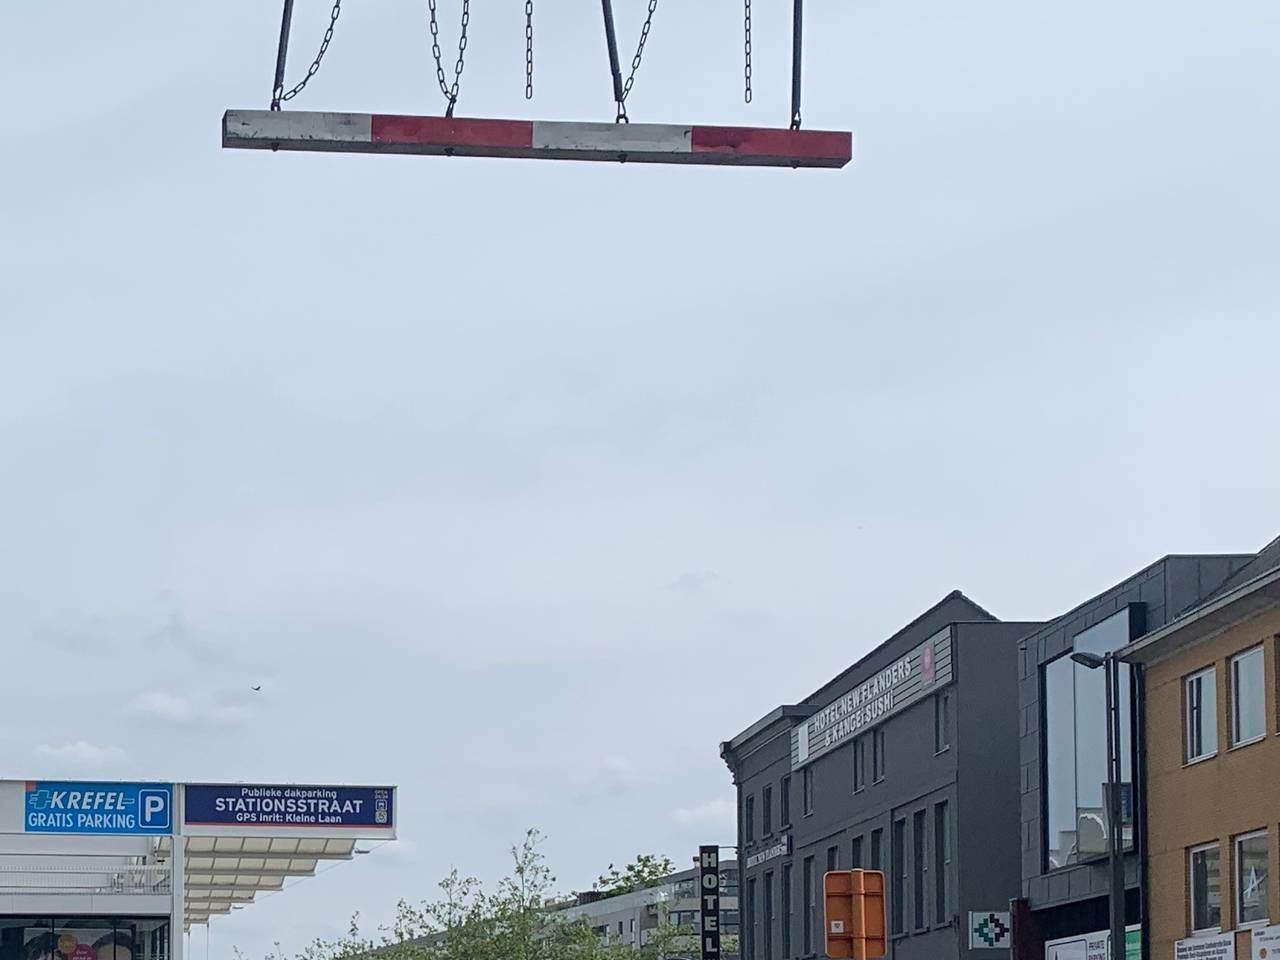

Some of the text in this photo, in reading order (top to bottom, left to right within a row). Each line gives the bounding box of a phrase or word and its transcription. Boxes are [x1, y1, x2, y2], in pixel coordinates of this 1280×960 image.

[814, 657, 912, 732] HOTEL NEW FLANDERS
[824, 730, 831, 747] &
[50, 791, 126, 810] KREFEL
[241, 788, 337, 799] Publieke dakparking
[145, 795, 165, 823] P
[215, 798, 363, 814] STATIONSSTRAAT
[28, 812, 136, 829] GRATIS PARKING
[236, 812, 257, 822] GPS
[285, 813, 316, 823] Kleine
[318, 814, 342, 824] Laan
[702, 853, 718, 953] HOTEL
